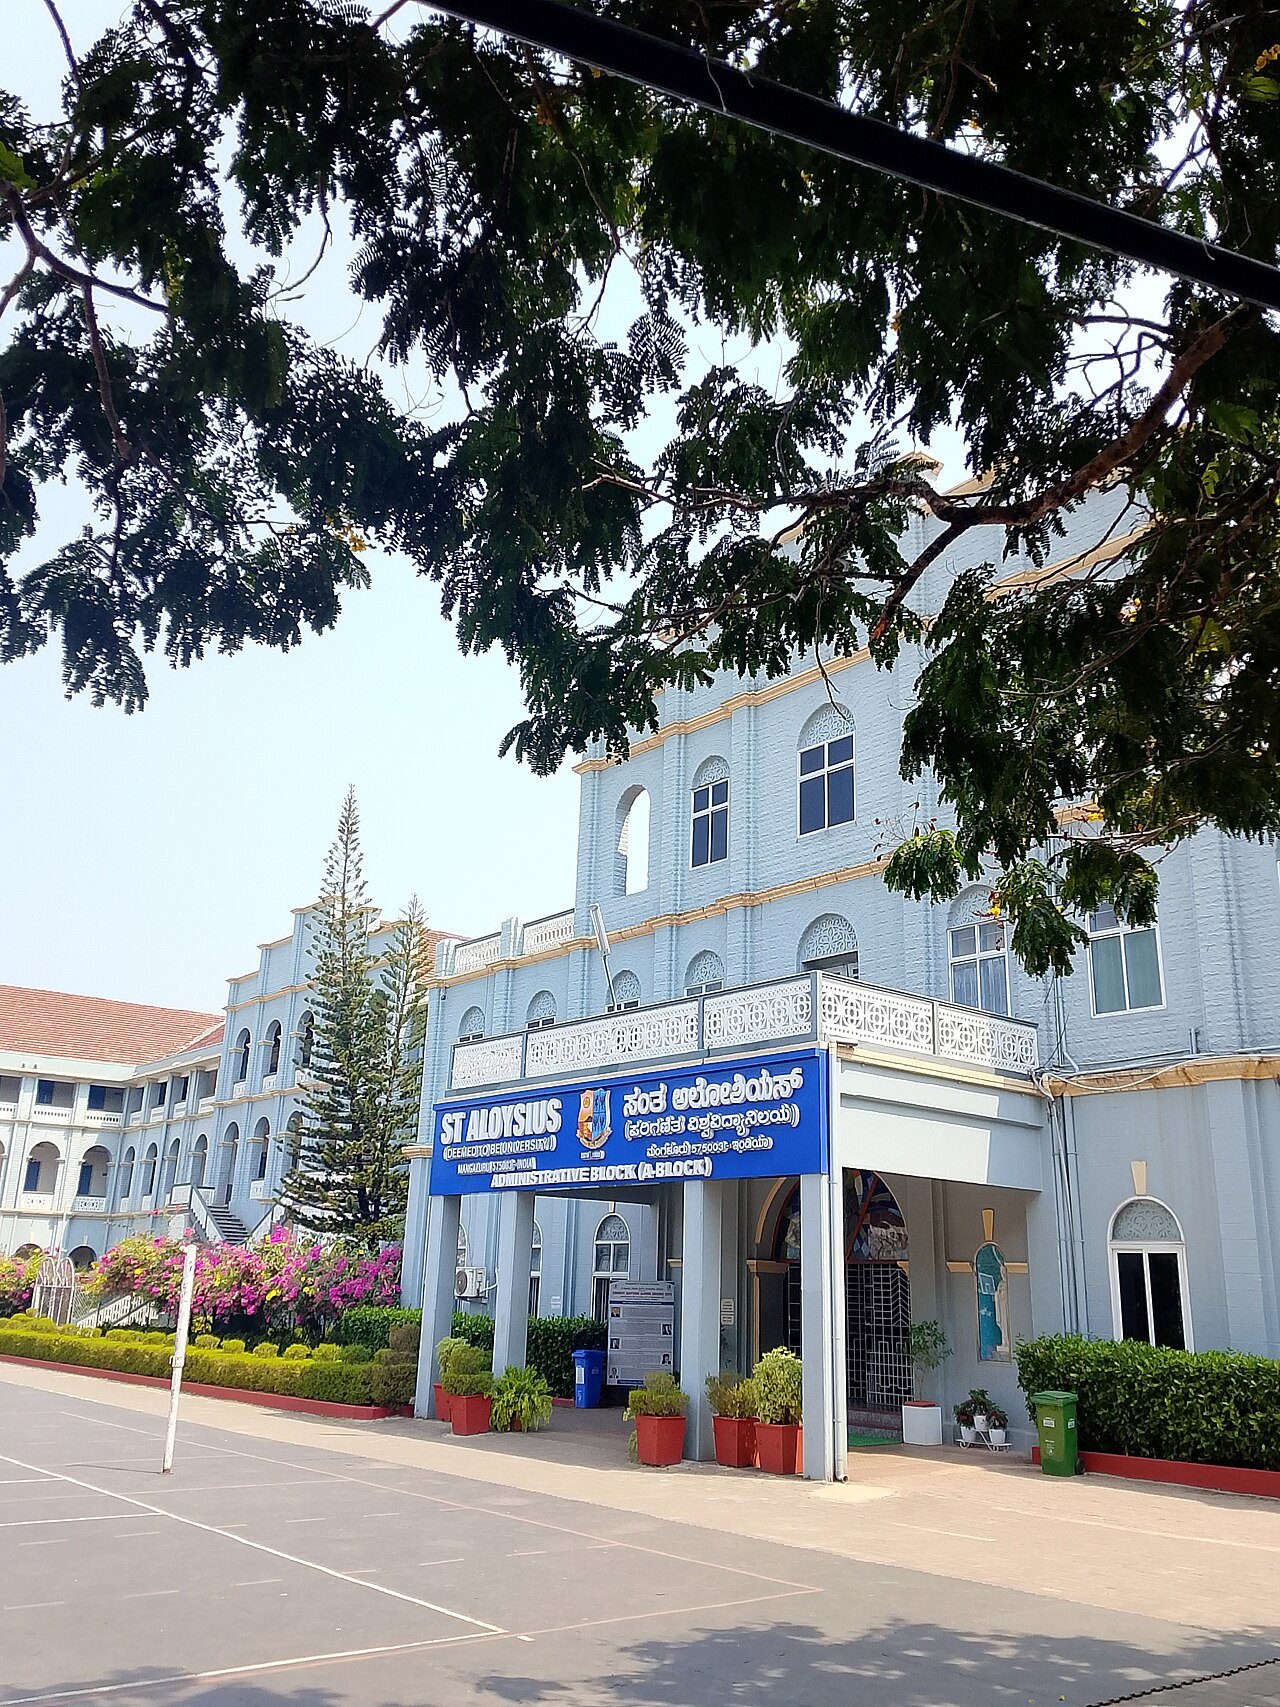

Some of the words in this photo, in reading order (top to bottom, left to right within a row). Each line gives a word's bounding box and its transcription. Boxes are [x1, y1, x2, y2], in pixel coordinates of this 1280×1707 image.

[623, 1083, 667, 1117] ಸಂತ
[440, 1112, 466, 1145] ST
[466, 1098, 563, 1142] ALOYSIUS
[443, 1146, 478, 1161] (DEEMED
[478, 1145, 490, 1158] TO
[490, 1143, 501, 1156] BE
[501, 1134, 557, 1155] UNIVERSITY)
[691, 1140, 728, 1155] 575003
[490, 1167, 590, 1188] ADMINISTRATIVE
[590, 1164, 638, 1182] BLOCK
[638, 1156, 713, 1181] (A-BLOCK)
